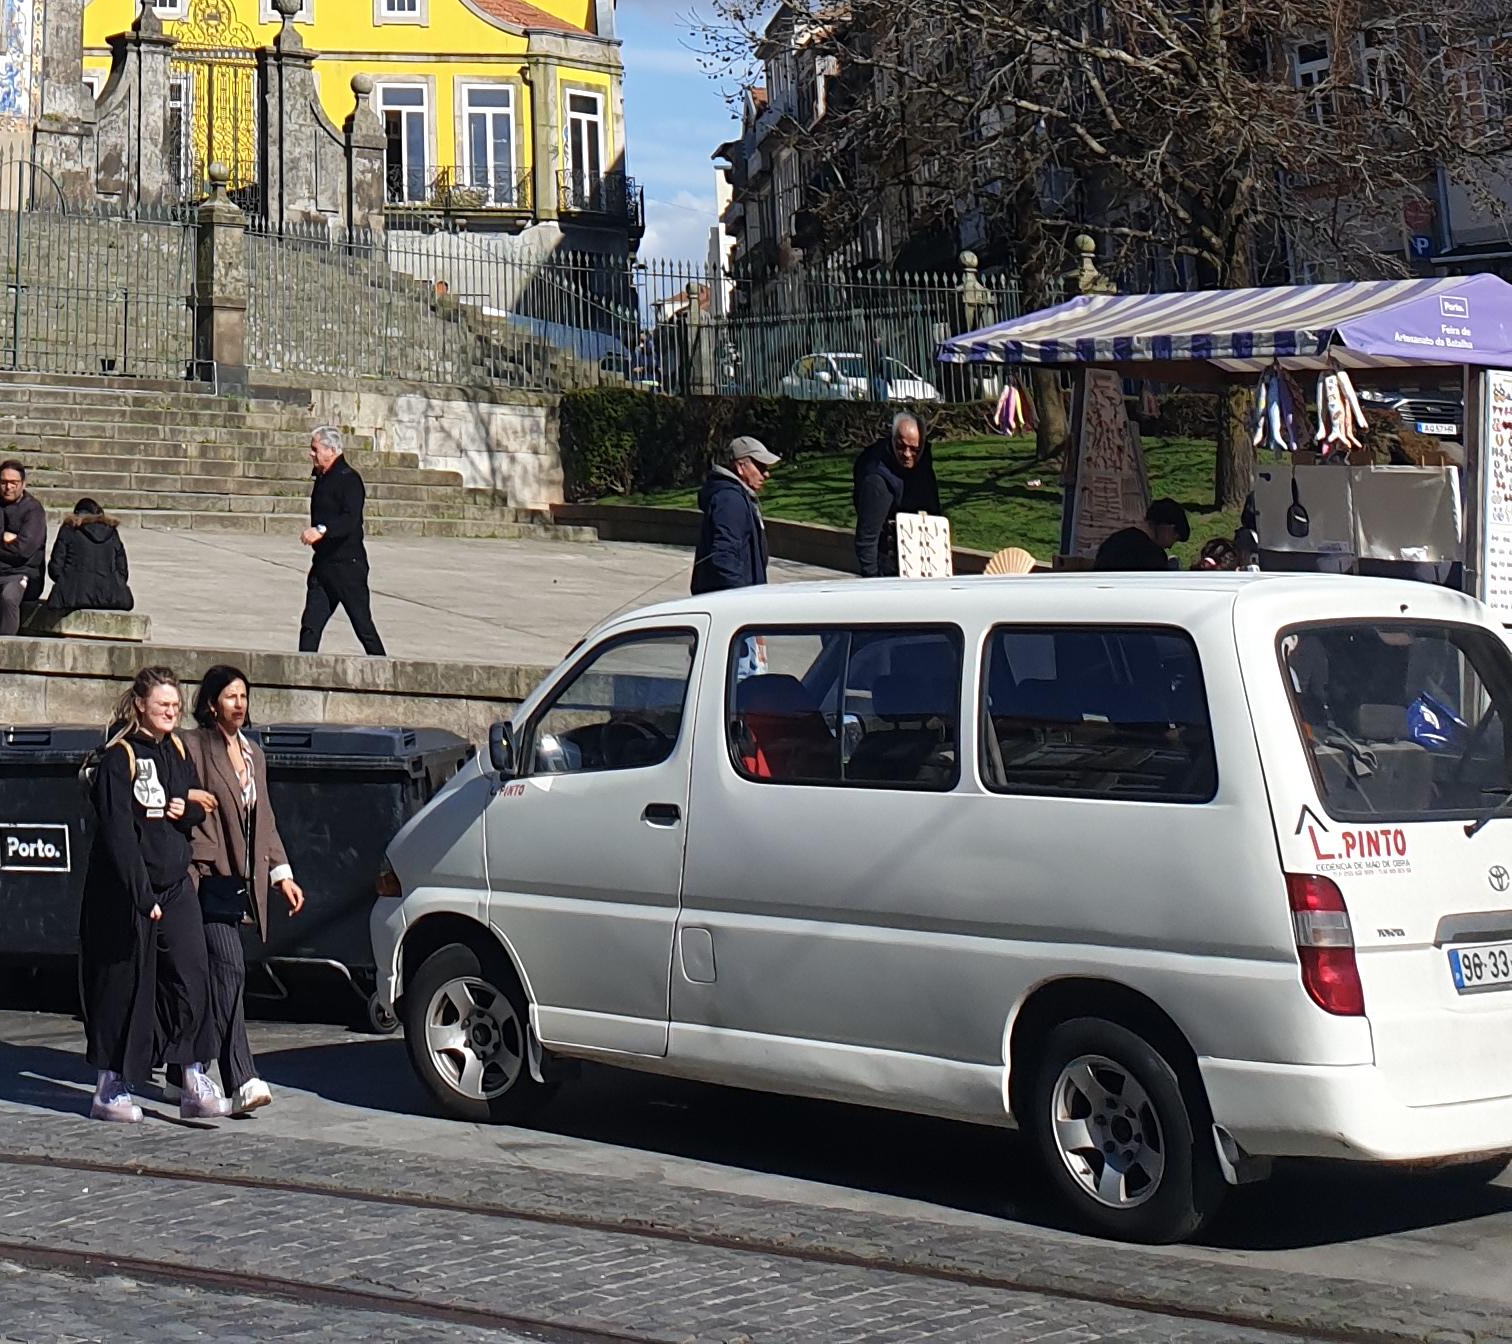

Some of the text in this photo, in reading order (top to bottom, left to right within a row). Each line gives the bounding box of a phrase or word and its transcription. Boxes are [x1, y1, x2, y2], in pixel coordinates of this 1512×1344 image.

[1415, 237, 1429, 255] P
[1441, 323, 1471, 337] Feira de
[6, 836, 61, 859] Porto.
